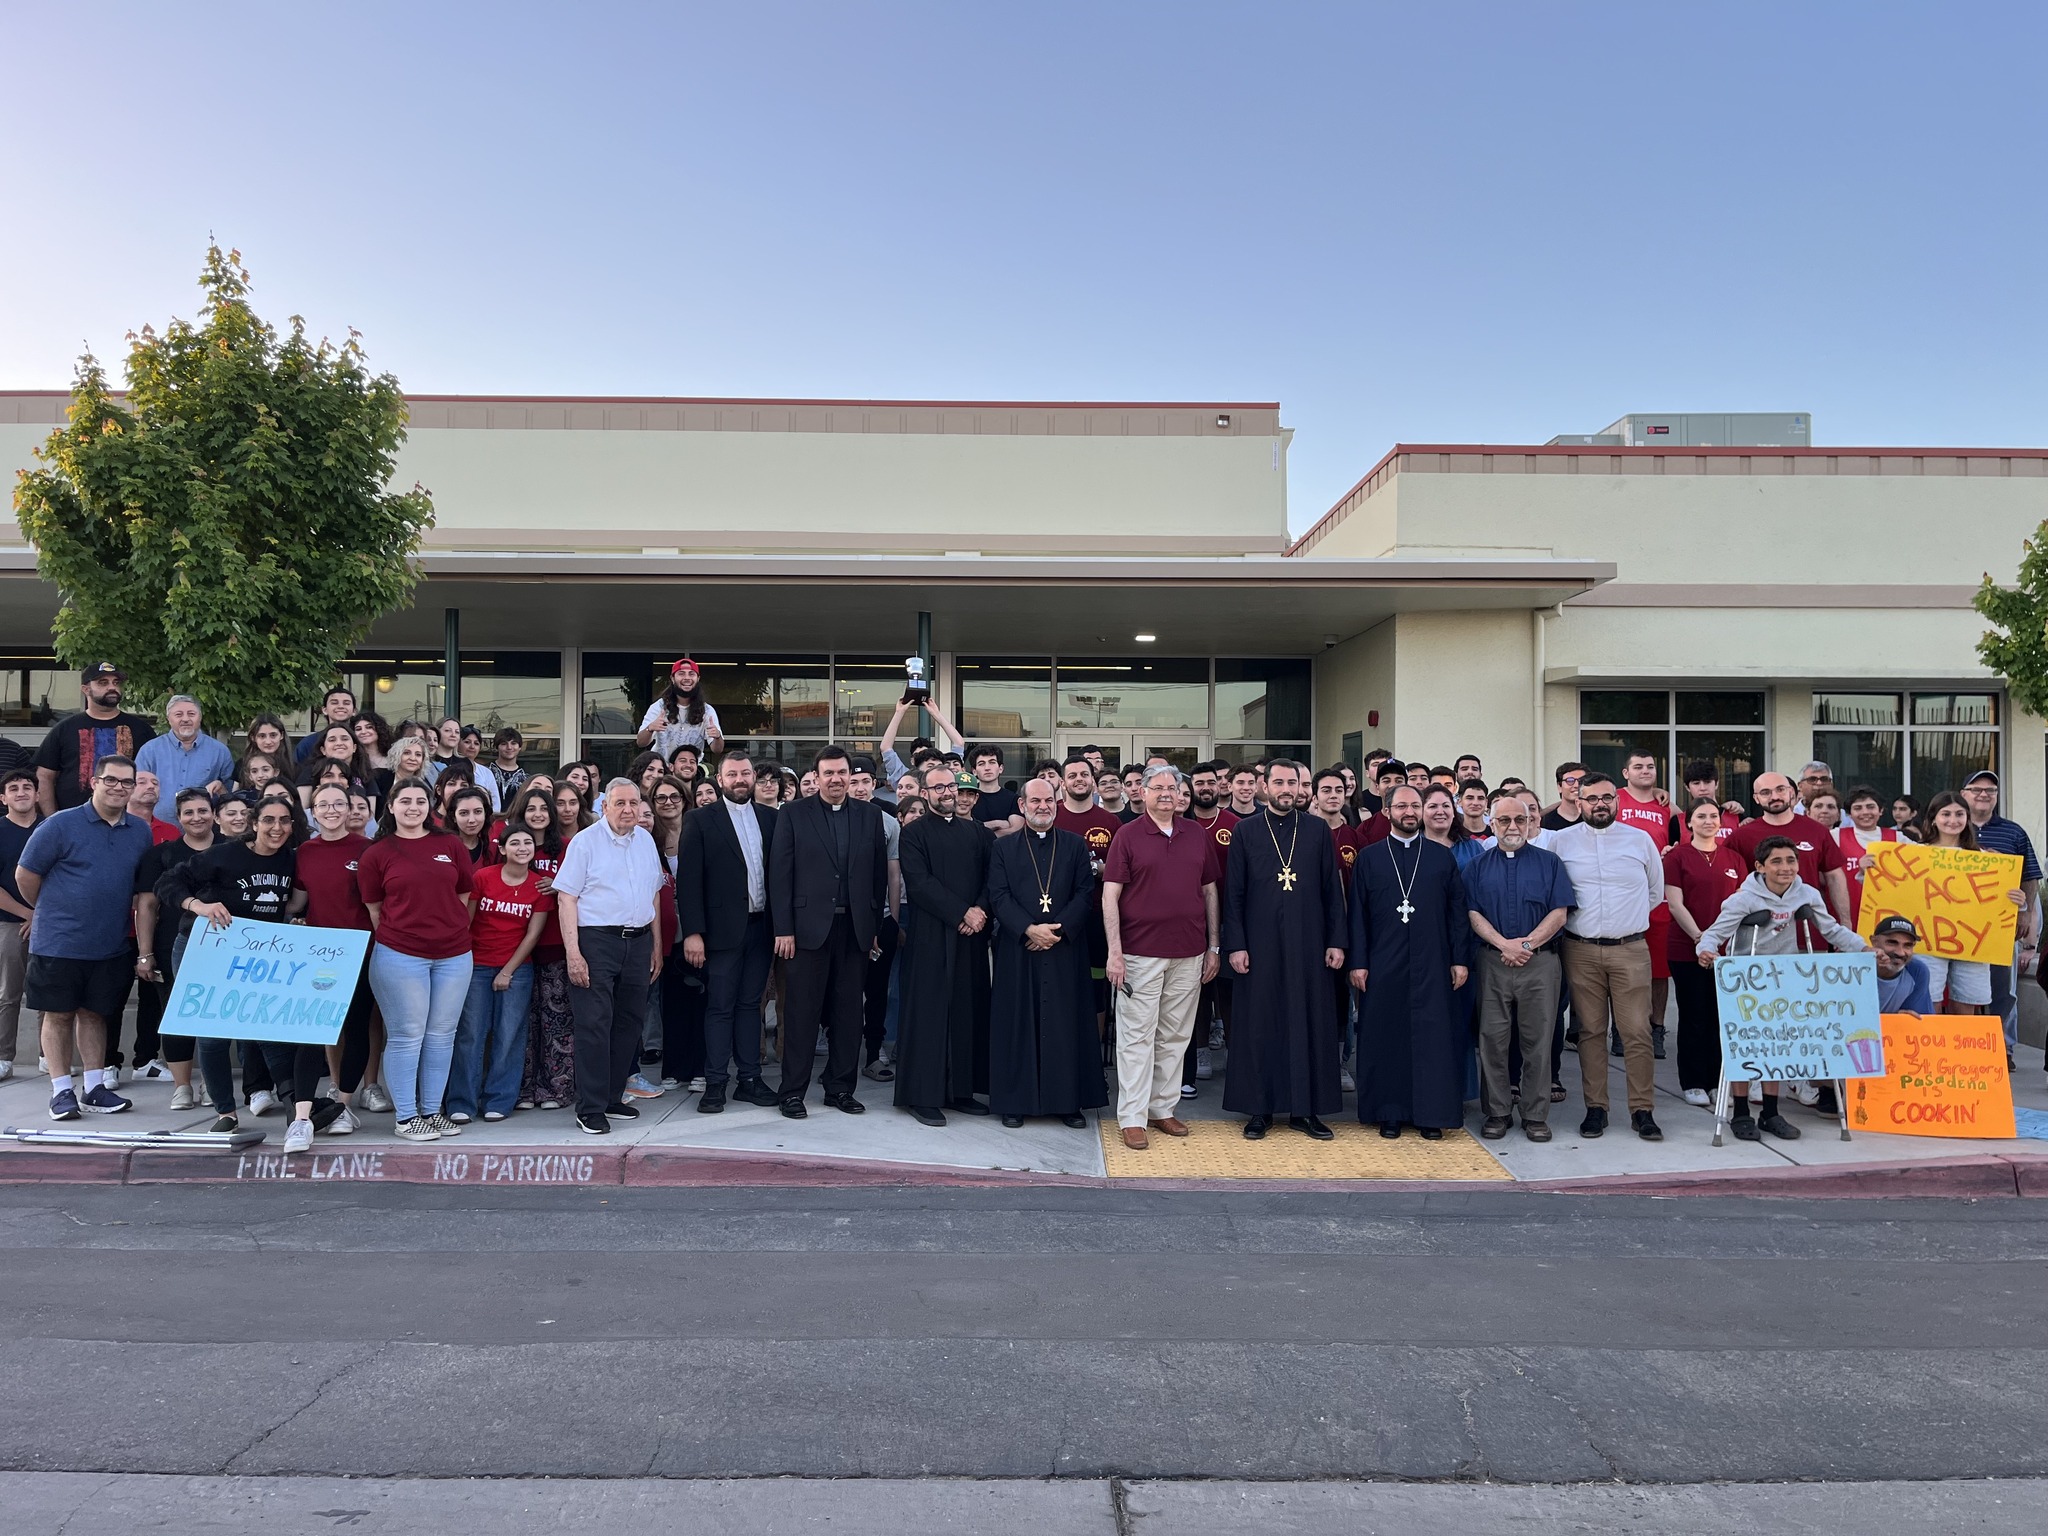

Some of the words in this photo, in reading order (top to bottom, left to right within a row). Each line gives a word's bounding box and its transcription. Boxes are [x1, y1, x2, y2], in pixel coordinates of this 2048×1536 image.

[1622, 808, 1634, 821] ST.
[1635, 809, 1664, 826] MARY'S
[1866, 844, 1930, 892] ACE
[1954, 850, 2016, 872] Gregory
[251, 873, 279, 887] GREGORY
[1923, 870, 2000, 910] ACE
[479, 896, 494, 912] ST.
[495, 900, 533, 919] MARY'S
[226, 955, 308, 986] HOLY
[1716, 958, 1784, 994] Get
[1799, 1042, 1824, 1057] on
[1831, 1044, 1844, 1057] a
[1903, 1034, 1946, 1060] you
[1936, 1057, 2004, 1083] Gregory
[236, 1152, 296, 1179] FIRE
[311, 1151, 384, 1179] LANE
[433, 1153, 469, 1180] NO
[481, 1154, 594, 1182] PARKING
